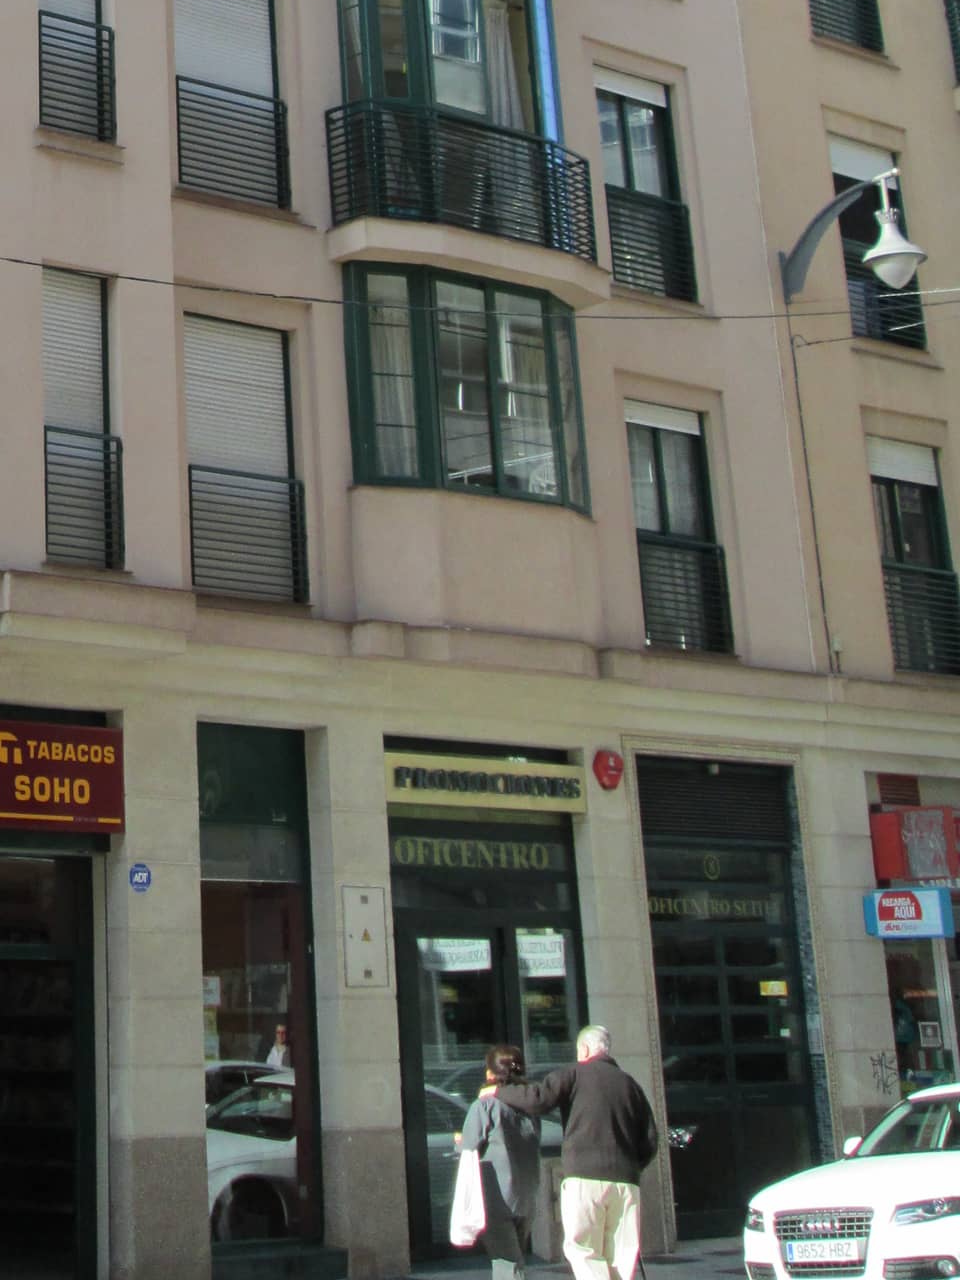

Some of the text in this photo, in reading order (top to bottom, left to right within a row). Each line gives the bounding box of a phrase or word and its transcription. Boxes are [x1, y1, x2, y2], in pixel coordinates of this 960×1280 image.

[26, 739, 116, 765] TABACOS
[14, 774, 91, 805] SOHO
[393, 765, 582, 800] PROMOCIONES
[394, 836, 550, 869] OFICENTRO
[133, 871, 149, 884] ADT
[649, 895, 730, 916] OFICENTRO
[796, 1241, 852, 1259] 9652 HBZ
